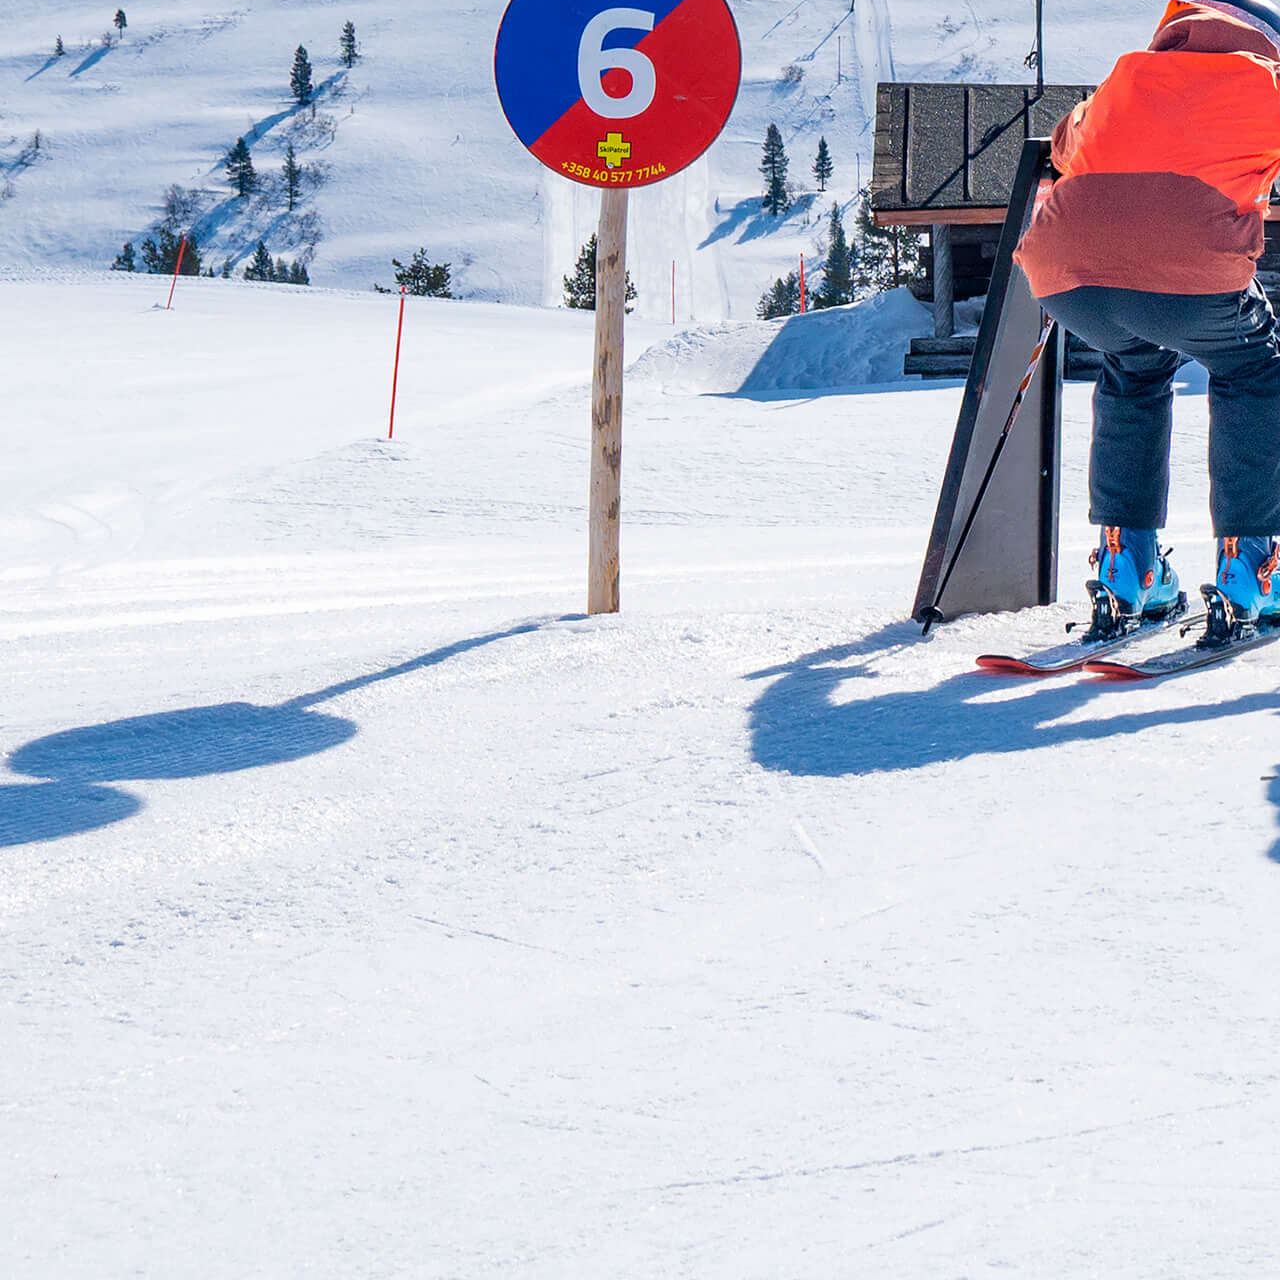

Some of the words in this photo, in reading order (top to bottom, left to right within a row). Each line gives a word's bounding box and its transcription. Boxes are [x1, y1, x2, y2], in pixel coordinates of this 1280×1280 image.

[577, 7, 656, 119] 6
[599, 145, 629, 153] SkiPatrol
[561, 161, 590, 179] +358
[592, 170, 608, 182] 40
[610, 171, 633, 183] 577
[636, 162, 667, 180] 7744
